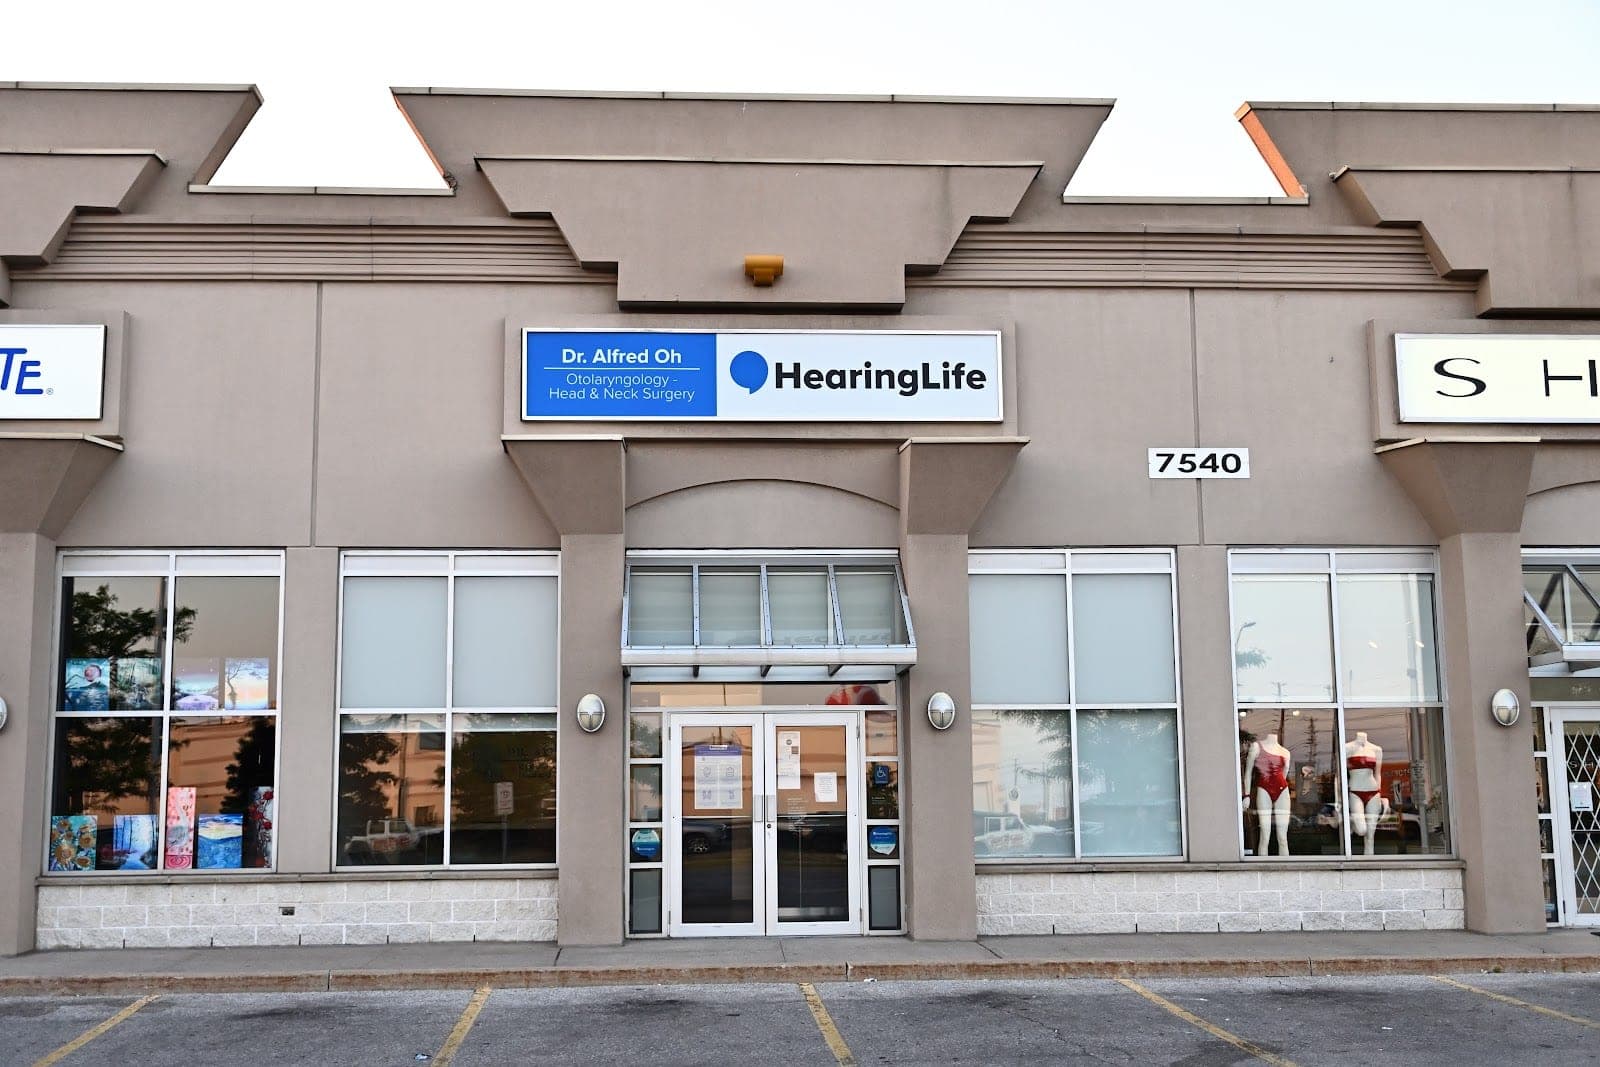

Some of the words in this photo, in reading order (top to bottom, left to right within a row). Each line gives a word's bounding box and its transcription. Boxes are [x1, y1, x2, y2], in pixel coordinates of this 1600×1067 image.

[561, 348, 588, 364] Dr.
[592, 348, 649, 364] Alfred
[654, 348, 682, 364] Oh
[566, 373, 669, 388] Otolaryngology
[775, 361, 987, 397] HearingLife
[549, 387, 586, 400] Head
[589, 387, 600, 400] &
[604, 387, 639, 400] Neck
[643, 387, 696, 402] Surgery
[1155, 453, 1242, 474] 7540
